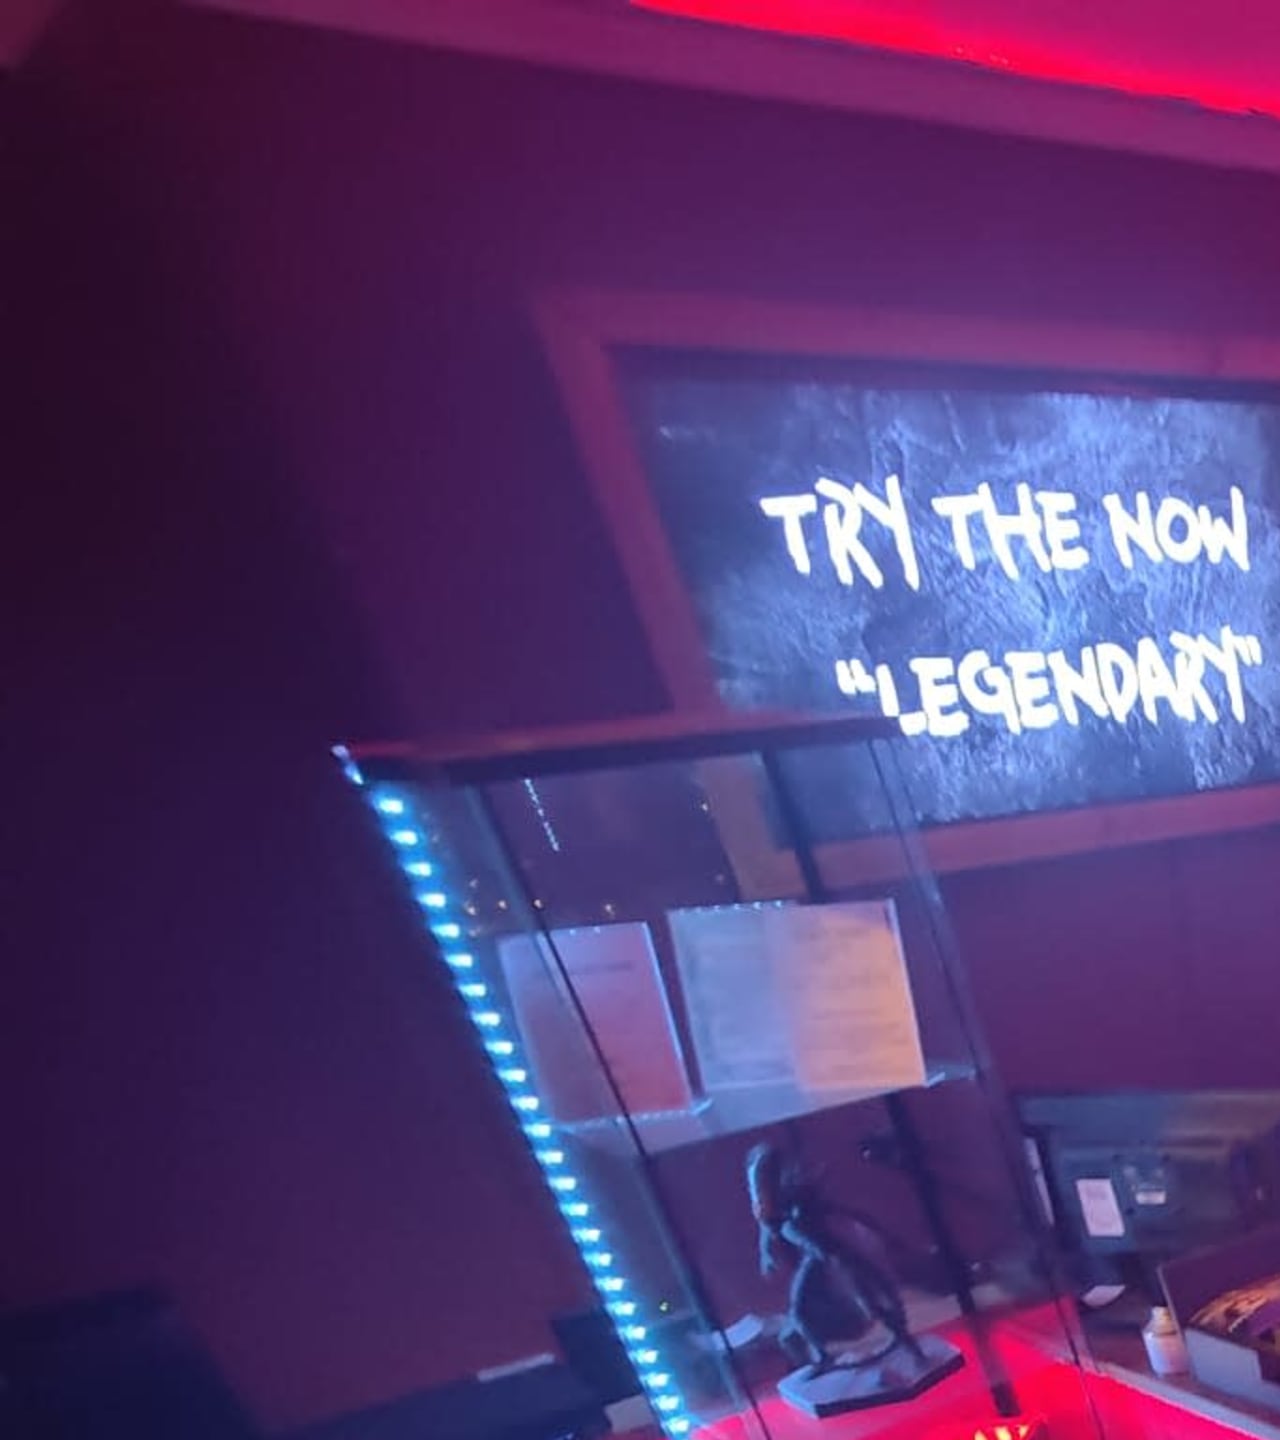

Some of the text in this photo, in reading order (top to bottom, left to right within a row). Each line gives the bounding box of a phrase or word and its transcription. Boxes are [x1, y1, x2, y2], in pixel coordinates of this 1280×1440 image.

[760, 474, 1251, 590] TRY THE NOW
